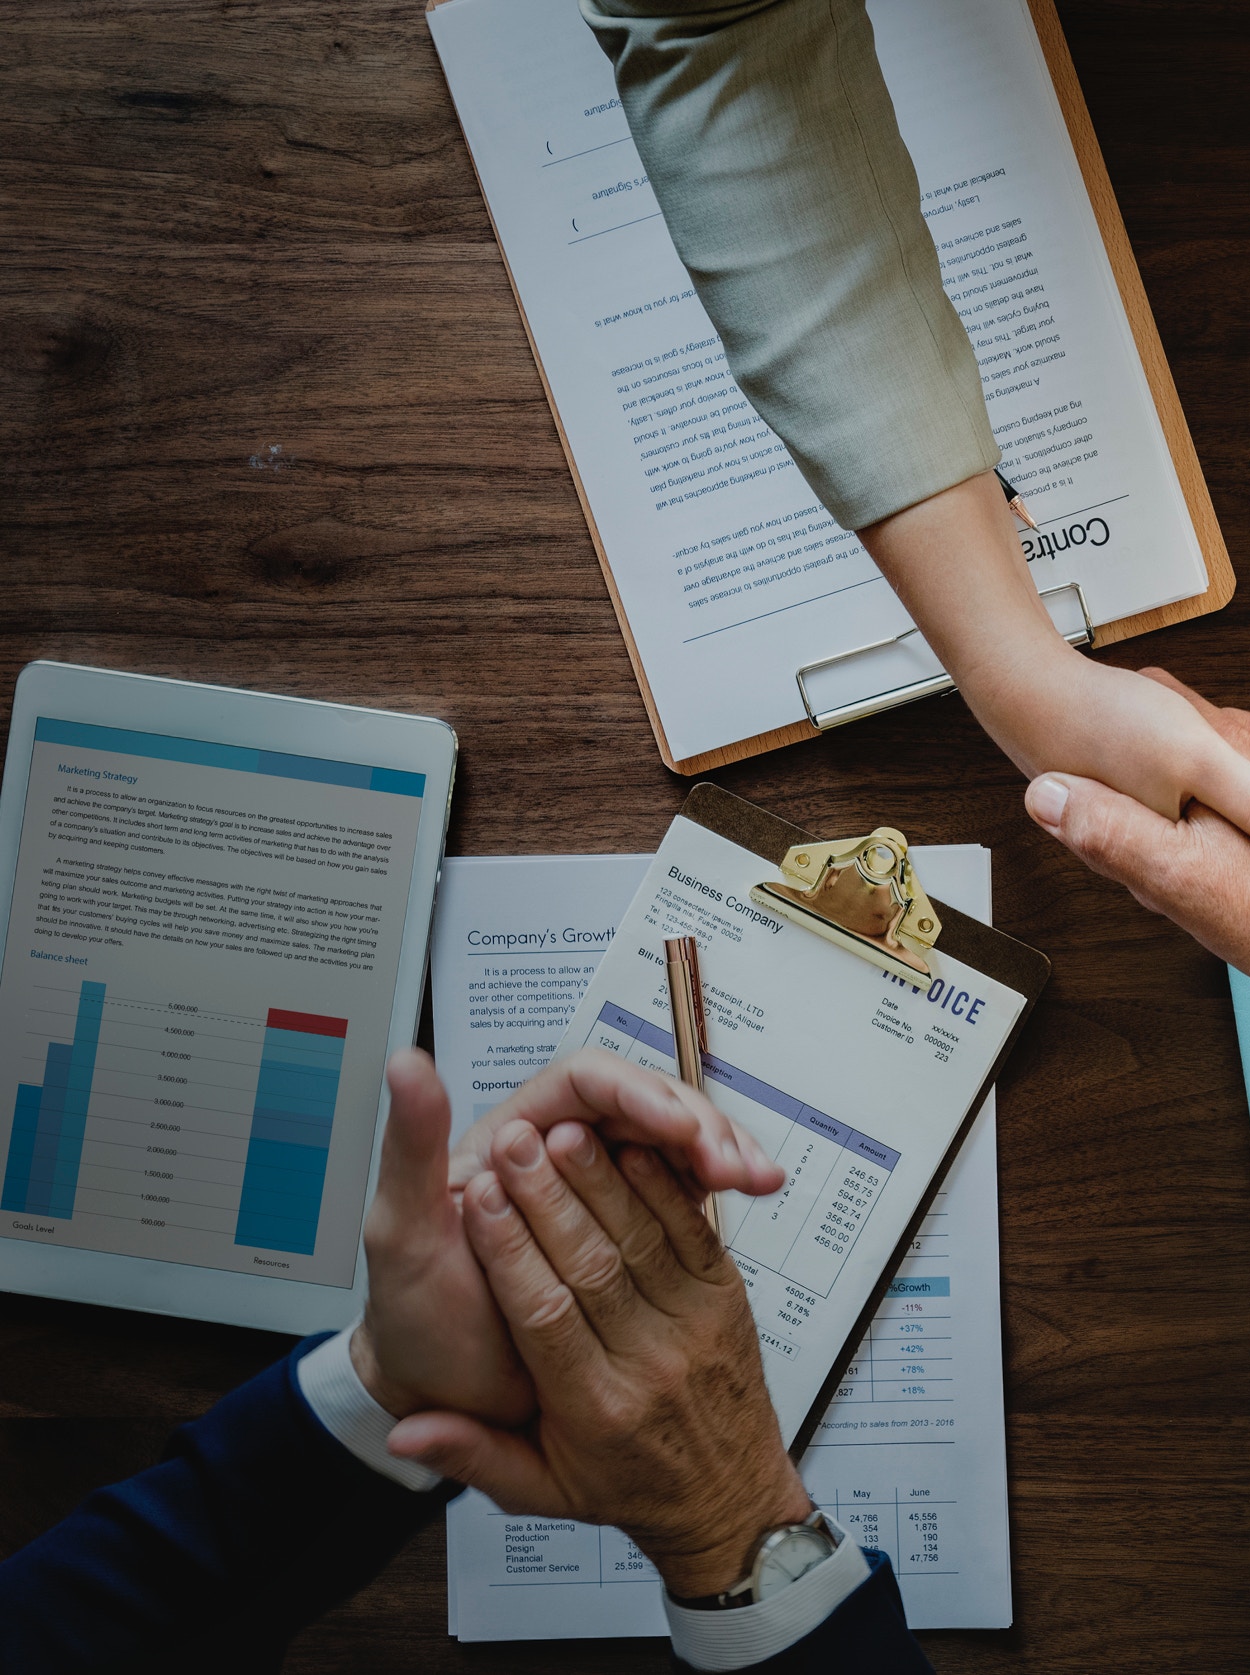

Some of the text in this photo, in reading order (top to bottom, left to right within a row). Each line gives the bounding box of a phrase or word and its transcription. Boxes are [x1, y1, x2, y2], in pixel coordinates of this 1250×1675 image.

[590, 180, 633, 200] Signature
[632, 399, 747, 444] should be innovative. It should
[997, 416, 1088, 454] company's situation and
[1021, 432, 1093, 461] other competitions.
[1020, 516, 1110, 562] Contra
[57, 763, 138, 785] Marketing Strategy
[667, 865, 723, 902] Business
[725, 895, 784, 935] Company
[467, 928, 557, 949] Company's
[30, 949, 88, 966] Balance sheet
[637, 947, 664, 966] Bill to
[484, 965, 595, 977] It is a process to allow an
[468, 978, 589, 990] and achieve the company's
[881, 968, 986, 1025] OICE
[881, 997, 899, 1011] Date
[469, 1004, 576, 1017] analysis of a company's
[616, 1015, 628, 1027] No.
[717, 1015, 739, 1031] 9999
[734, 1013, 765, 1033] Aliquet
[875, 1008, 914, 1034] Invoice No.
[871, 1018, 914, 1044] Customer ID
[931, 1025, 960, 1043] xx/xx/xx
[599, 1036, 620, 1052] 1234
[923, 1033, 954, 1054] 0000001
[934, 1050, 949, 1063] 223
[809, 1116, 840, 1137] Quantity
[805, 1144, 814, 1153] 2
[858, 1142, 887, 1161] Amount
[800, 1155, 808, 1164] 5
[794, 1166, 802, 1175] 8
[848, 1166, 879, 1187] 246.53
[842, 1177, 873, 1198] 855.75
[837, 1188, 868, 1208] 594.67
[831, 1201, 861, 1220] 492.74
[12, 1220, 55, 1234] Goals Level
[825, 1211, 856, 1232] 356.40
[819, 1223, 850, 1243] 400.00
[813, 1235, 844, 1255] 456.00
[252, 1256, 290, 1269] Resources
[784, 1285, 816, 1306] 4500.45
[786, 1300, 810, 1318] 6.78%
[901, 1303, 923, 1312] -11%
[777, 1309, 802, 1327] 740.67
[899, 1324, 924, 1333] +37%
[760, 1332, 794, 1356] 5241.12
[900, 1344, 924, 1353] +42%
[901, 1385, 926, 1395] +18%
[860, 1418, 955, 1429] to sales from 2013 2016
[853, 1489, 871, 1500] May
[909, 1488, 931, 1497] June
[849, 1513, 879, 1523] 24,766
[908, 1512, 938, 1522] 45,556
[504, 1520, 577, 1533] Sale Marketing
[914, 1522, 938, 1532] 1,876
[505, 1533, 550, 1543] Production
[505, 1544, 535, 1554] Design
[505, 1554, 543, 1563] Financial
[614, 1561, 644, 1571] 25,599
[909, 1553, 939, 1563] 47,756
[505, 1563, 580, 1574] Customer Service
